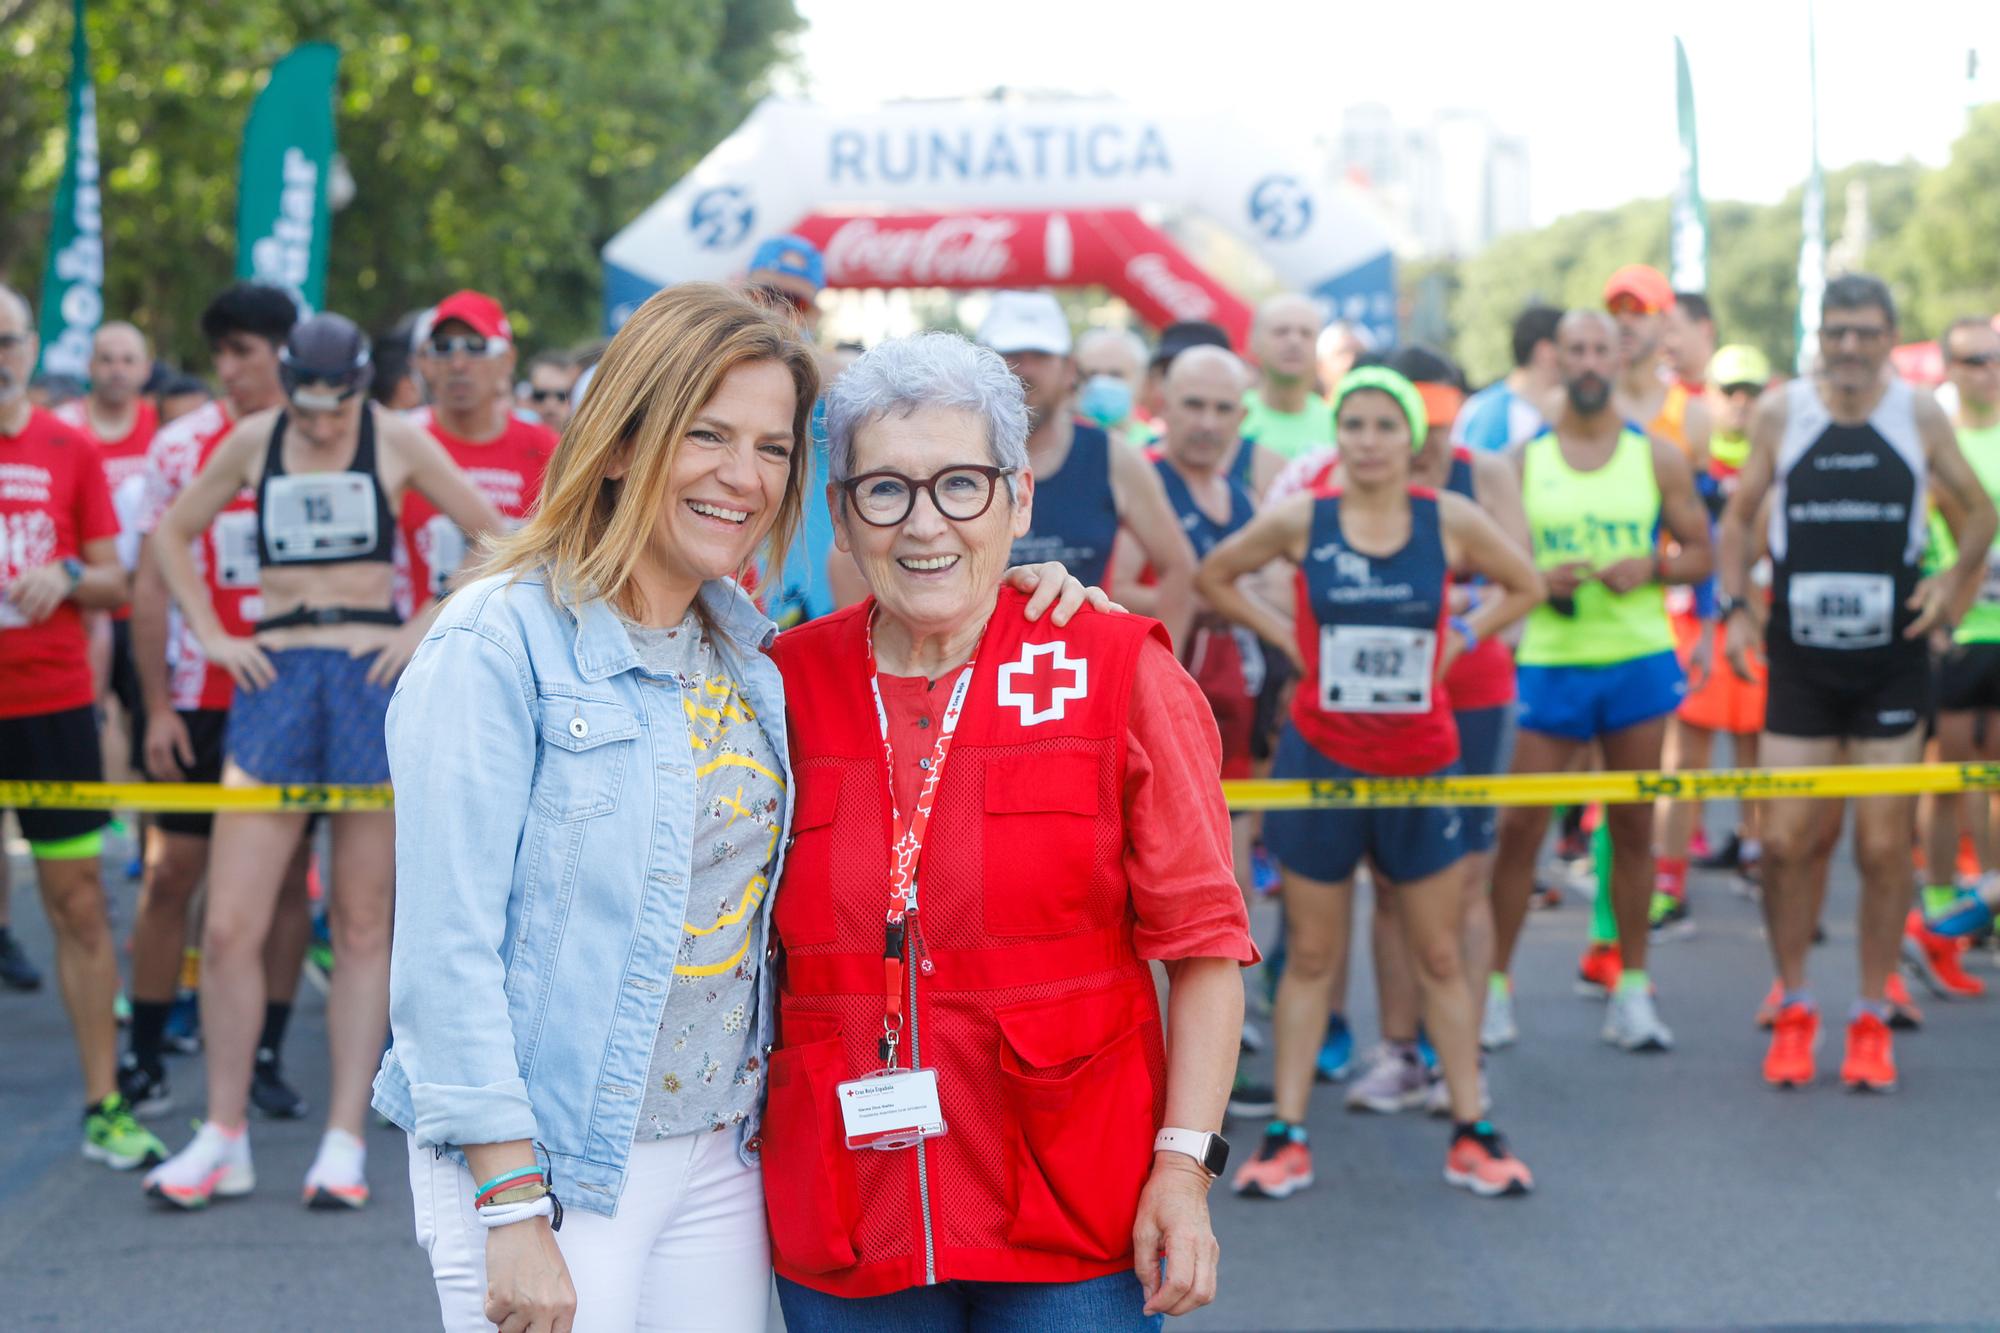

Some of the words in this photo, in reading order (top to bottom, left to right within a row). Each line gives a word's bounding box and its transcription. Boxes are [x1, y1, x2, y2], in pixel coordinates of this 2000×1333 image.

[829, 117, 1172, 183] RUNÁTICA
[305, 496, 333, 523] 15
[1354, 648, 1404, 677] 492
[911, 919, 920, 938] Cruz
[917, 938, 926, 957] Roja
